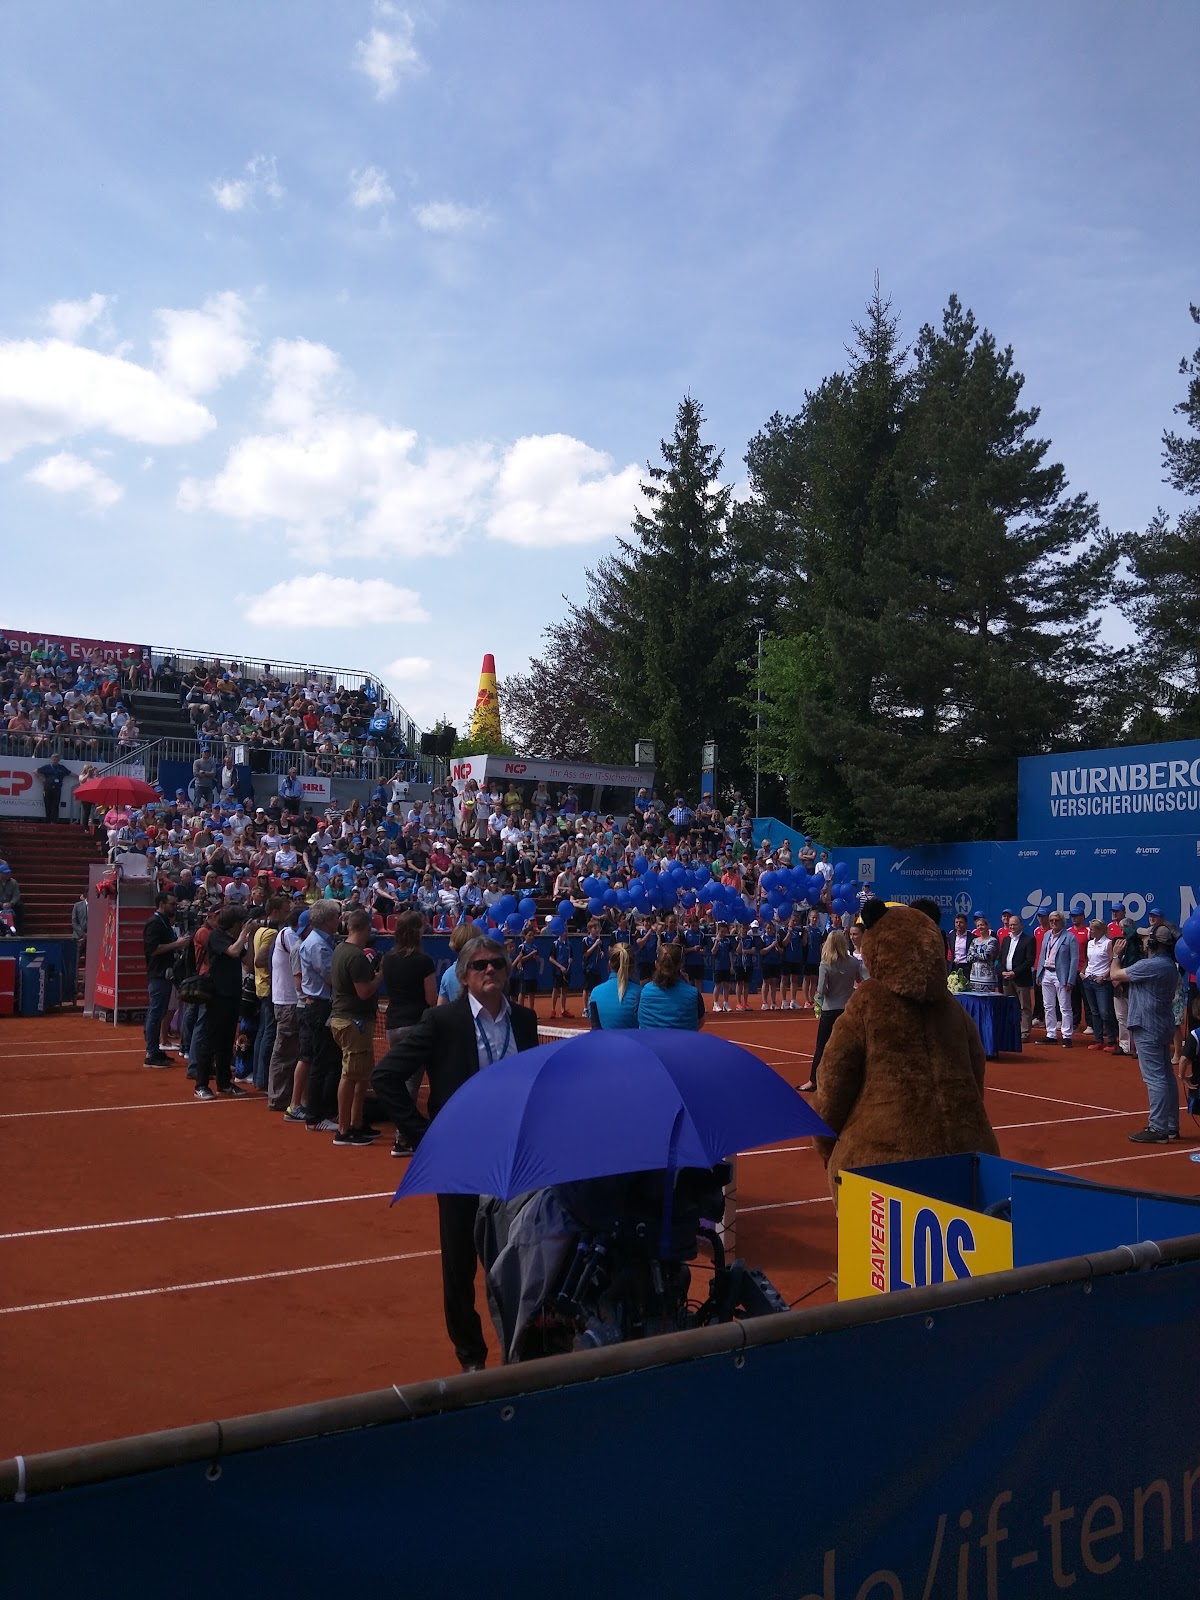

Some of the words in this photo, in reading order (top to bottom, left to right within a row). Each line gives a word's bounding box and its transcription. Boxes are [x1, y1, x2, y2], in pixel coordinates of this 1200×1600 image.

[5, 639, 32, 652] en
[70, 642, 123, 661] Evnt
[453, 763, 472, 780] NCP
[504, 763, 527, 774] NCP
[550, 767, 562, 778] Ihr
[563, 769, 578, 779] Ass
[579, 768, 593, 780] der
[595, 771, 644, 783] IT-Sicherheit
[1051, 790, 1200, 817] VERSICHERUNGSCU
[900, 868, 943, 877] metropolregion
[943, 867, 973, 877] nürnberg
[870, 1190, 886, 1293] BAYERN
[888, 1197, 977, 1293] LOS
